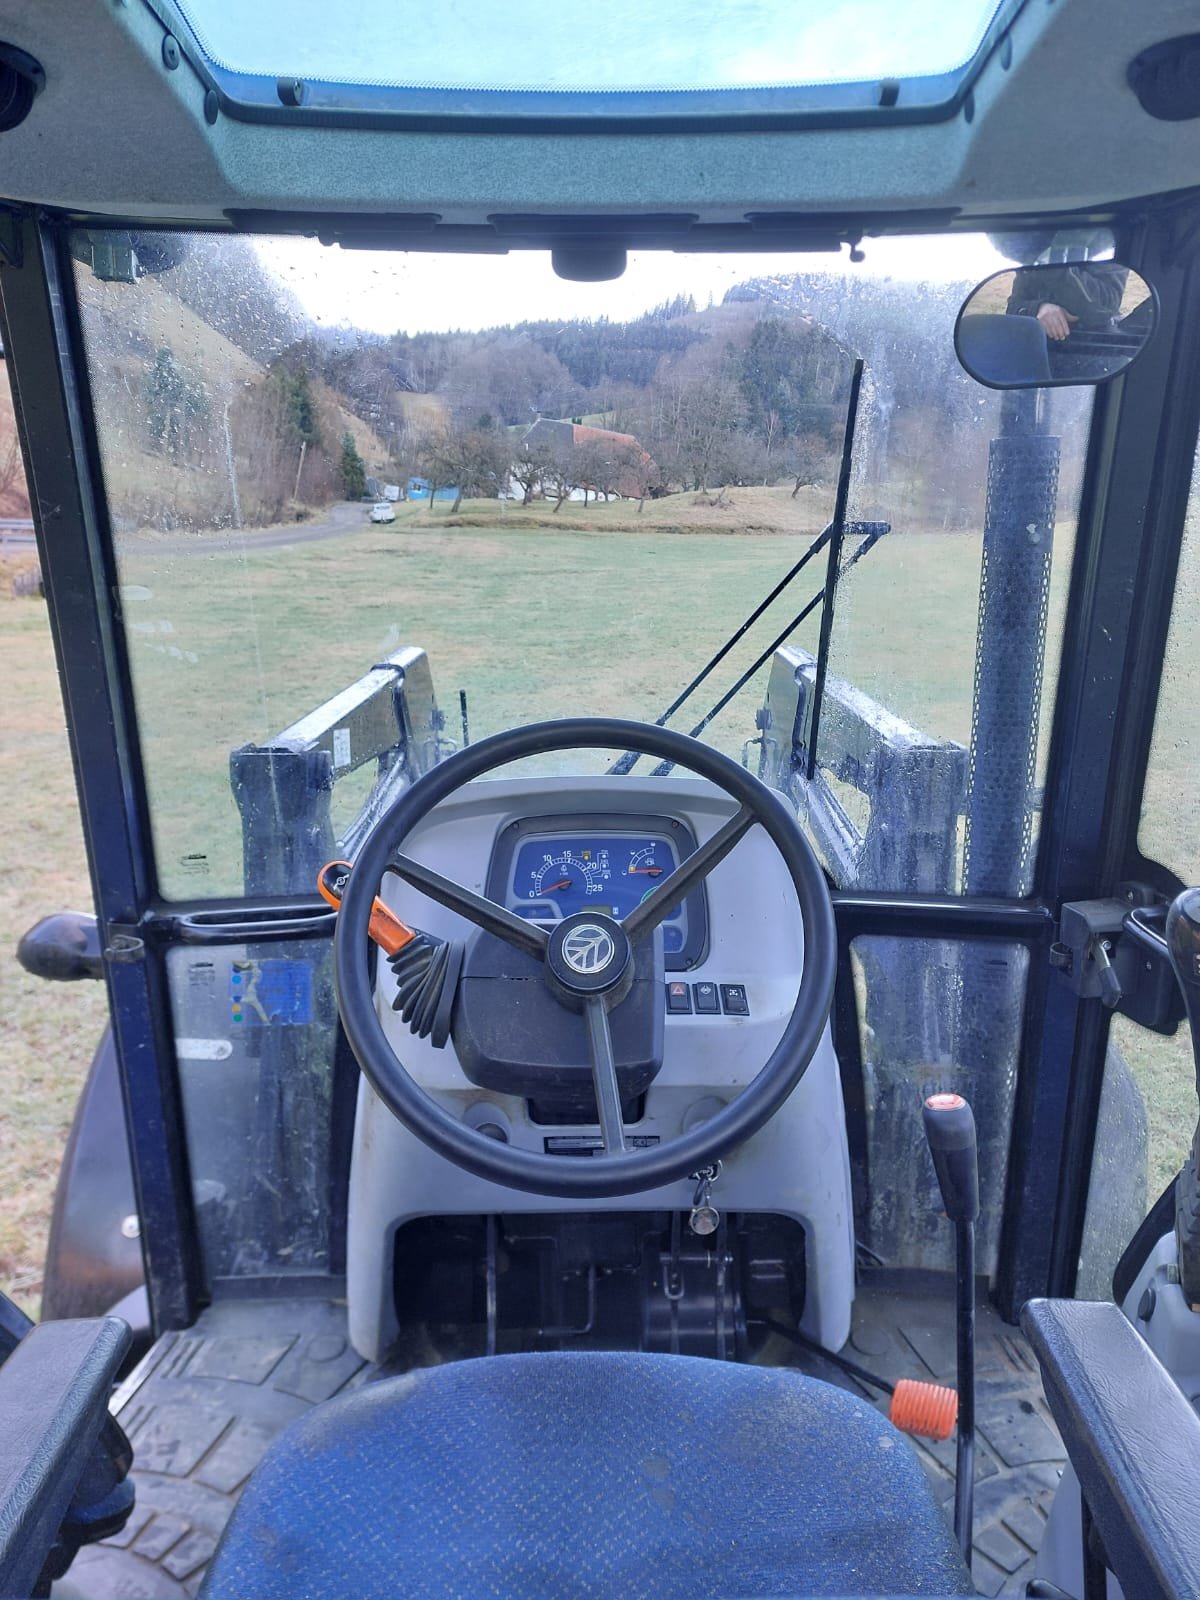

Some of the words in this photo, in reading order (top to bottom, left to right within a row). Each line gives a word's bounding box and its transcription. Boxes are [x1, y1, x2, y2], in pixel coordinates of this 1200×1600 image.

[543, 854, 552, 862] 10
[562, 850, 572, 858] 15
[531, 871, 537, 879] 5
[592, 884, 603, 892] 25
[529, 890, 535, 898] 0
